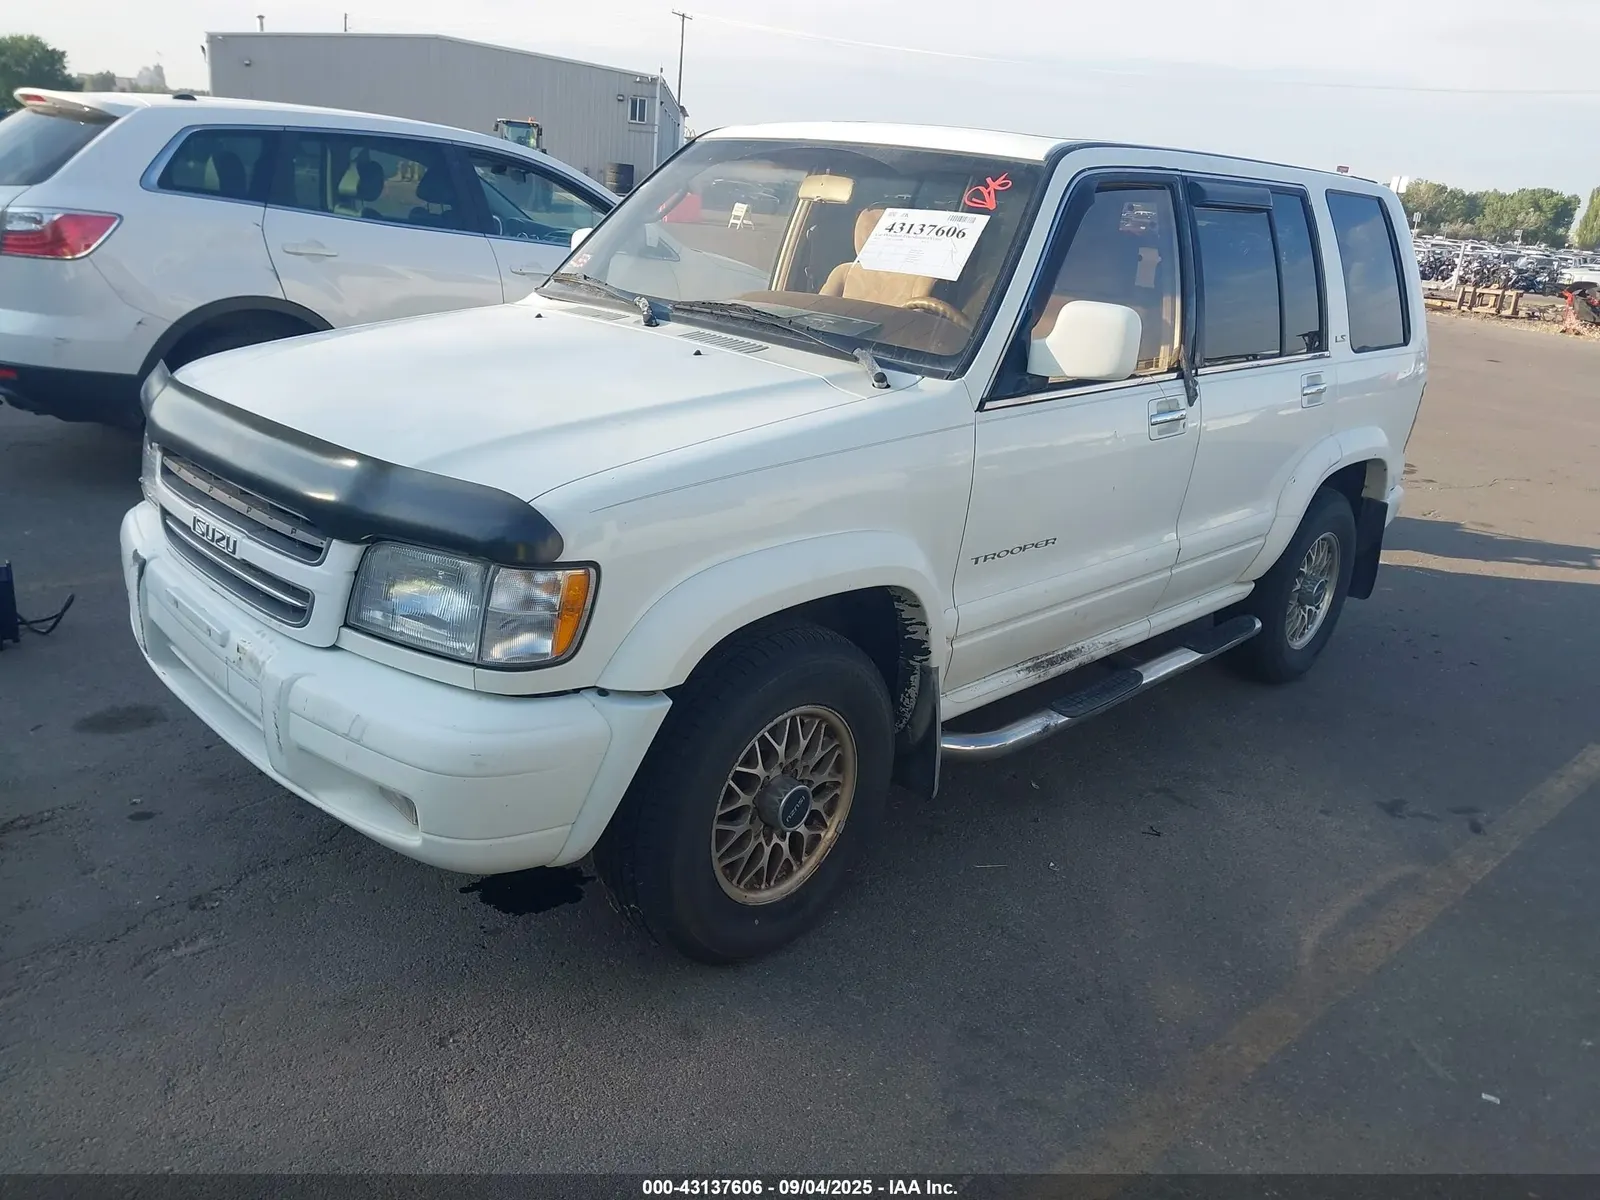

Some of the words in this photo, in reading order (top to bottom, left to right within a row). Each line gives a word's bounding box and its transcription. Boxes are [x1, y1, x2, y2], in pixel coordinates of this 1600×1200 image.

[885, 221, 967, 239] 43137606
[1334, 334, 1347, 343] LS
[192, 514, 237, 555] ISUZU
[970, 537, 1057, 565] TROOPER
[785, 795, 806, 822] ISUZU
